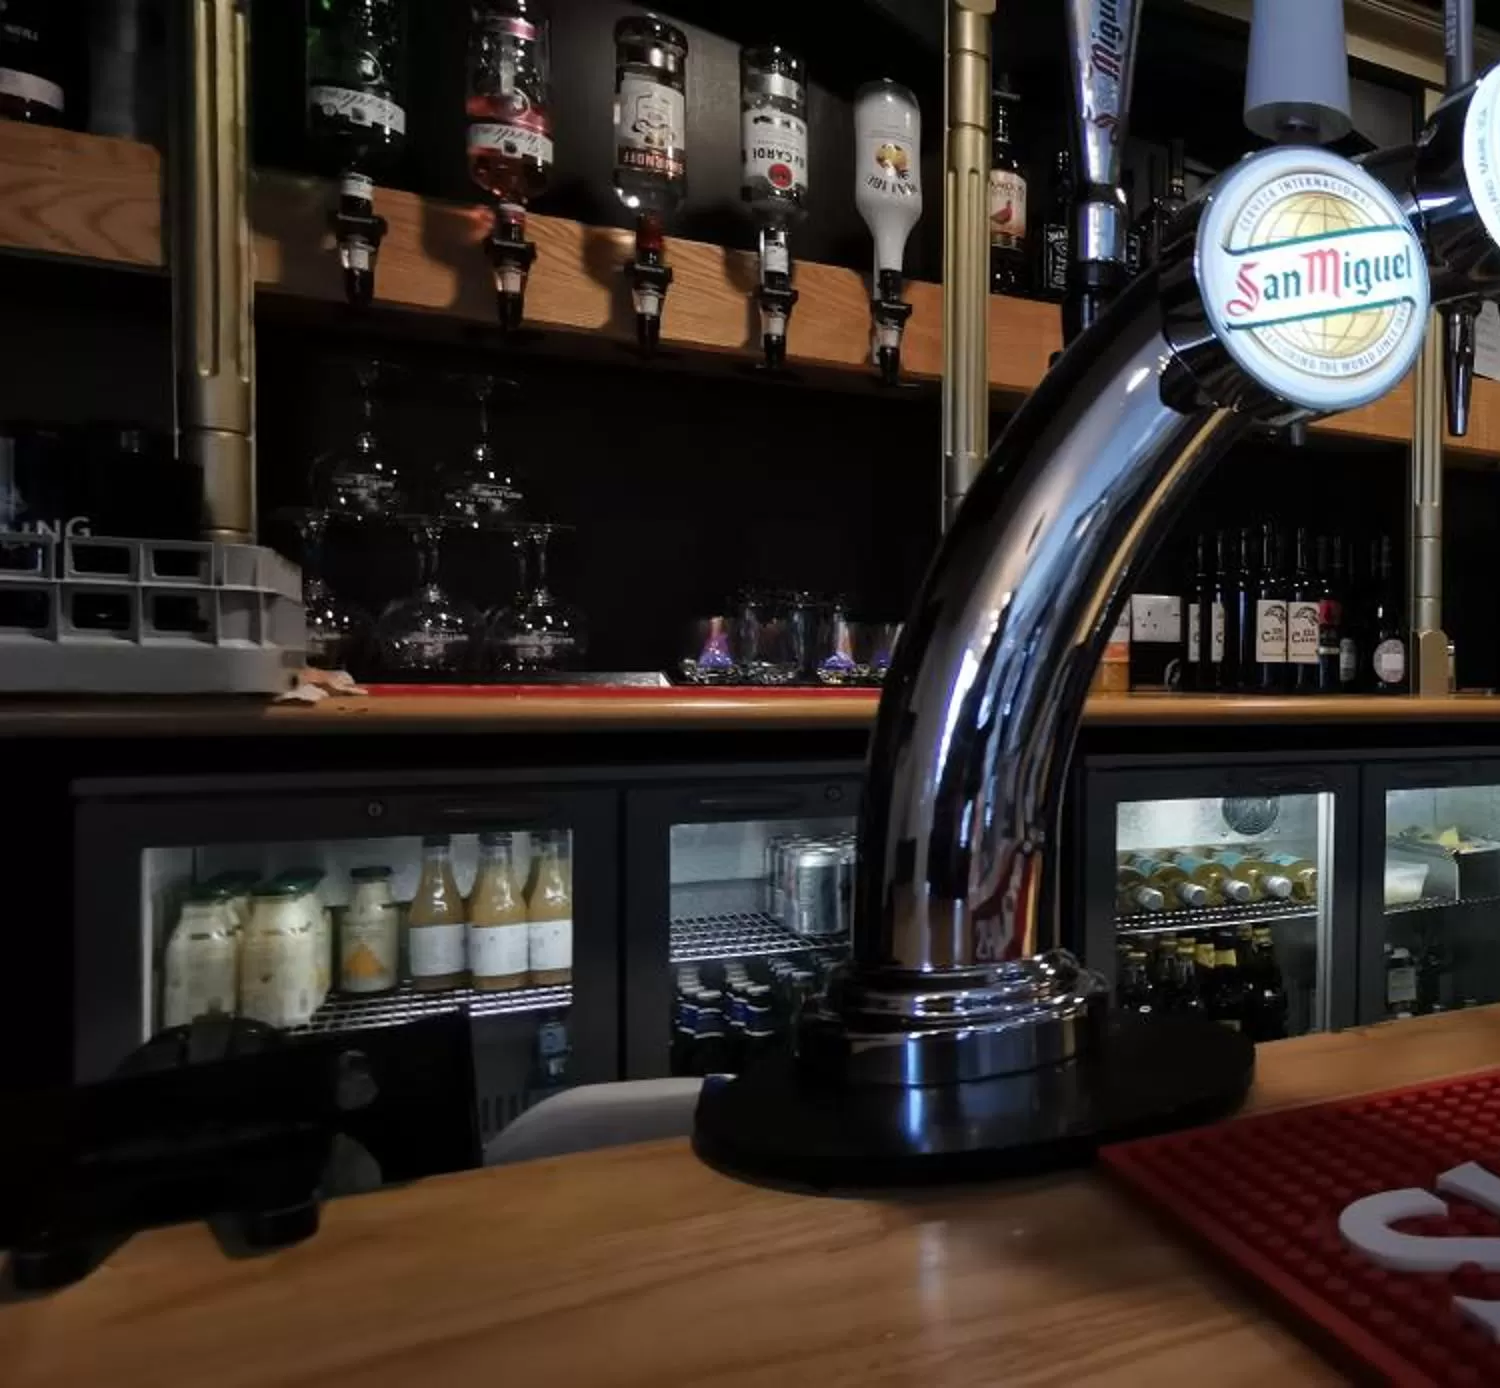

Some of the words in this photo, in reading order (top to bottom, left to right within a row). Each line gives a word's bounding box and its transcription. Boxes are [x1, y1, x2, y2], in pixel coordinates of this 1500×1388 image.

[1090, 0, 1123, 80] Migu
[1226, 262, 1300, 317] San
[1300, 246, 1412, 298] Miguel
